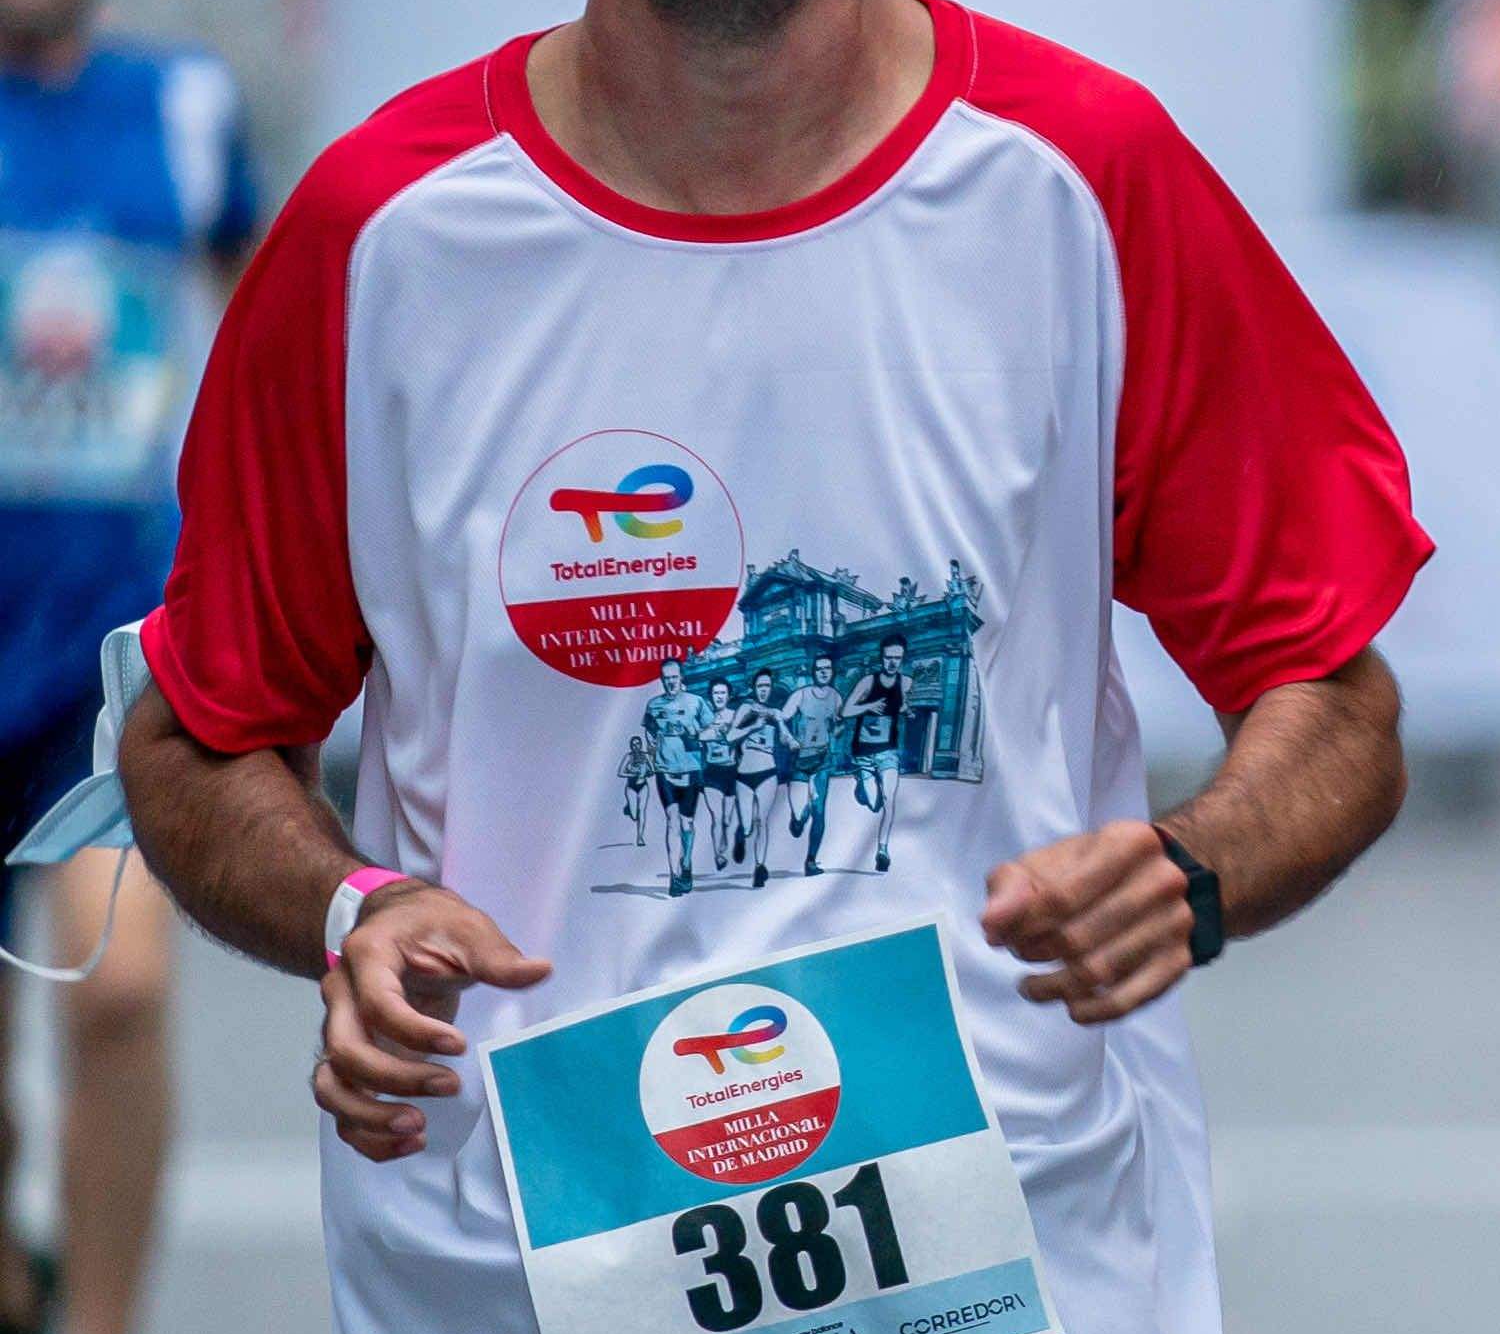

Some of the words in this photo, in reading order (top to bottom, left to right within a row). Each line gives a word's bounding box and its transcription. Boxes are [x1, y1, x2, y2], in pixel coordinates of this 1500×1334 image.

[551, 552, 697, 581] TotalEnergies
[590, 601, 656, 620] MILLA
[570, 651, 597, 668] DE
[605, 644, 682, 663] MADRID
[686, 1069, 803, 1109] TotalEnergies
[724, 1111, 779, 1135] MILLA
[712, 1159, 738, 1174] DE
[742, 1138, 809, 1167] MADRID
[671, 1161, 910, 1333] 381
